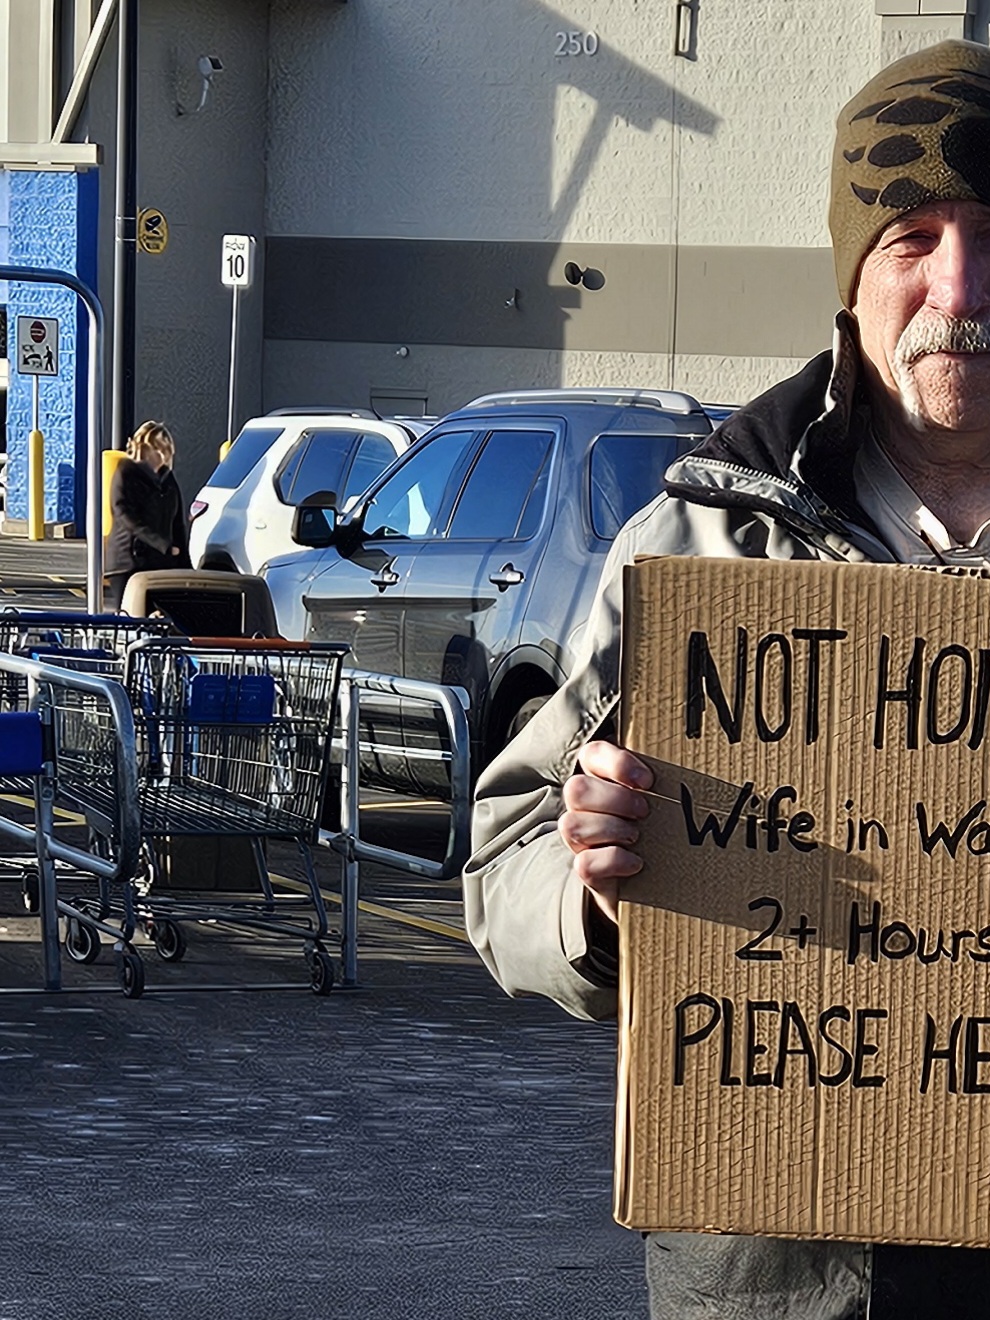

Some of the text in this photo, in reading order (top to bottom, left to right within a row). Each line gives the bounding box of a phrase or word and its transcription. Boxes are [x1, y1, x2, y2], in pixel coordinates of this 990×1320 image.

[554, 31, 599, 56] 250
[226, 254, 245, 278] 10
[686, 627, 847, 745] NOT
[680, 781, 818, 853] Wife
[845, 800, 889, 853] in
[735, 896, 817, 961] 2+
[674, 991, 888, 1090] PLEASE
